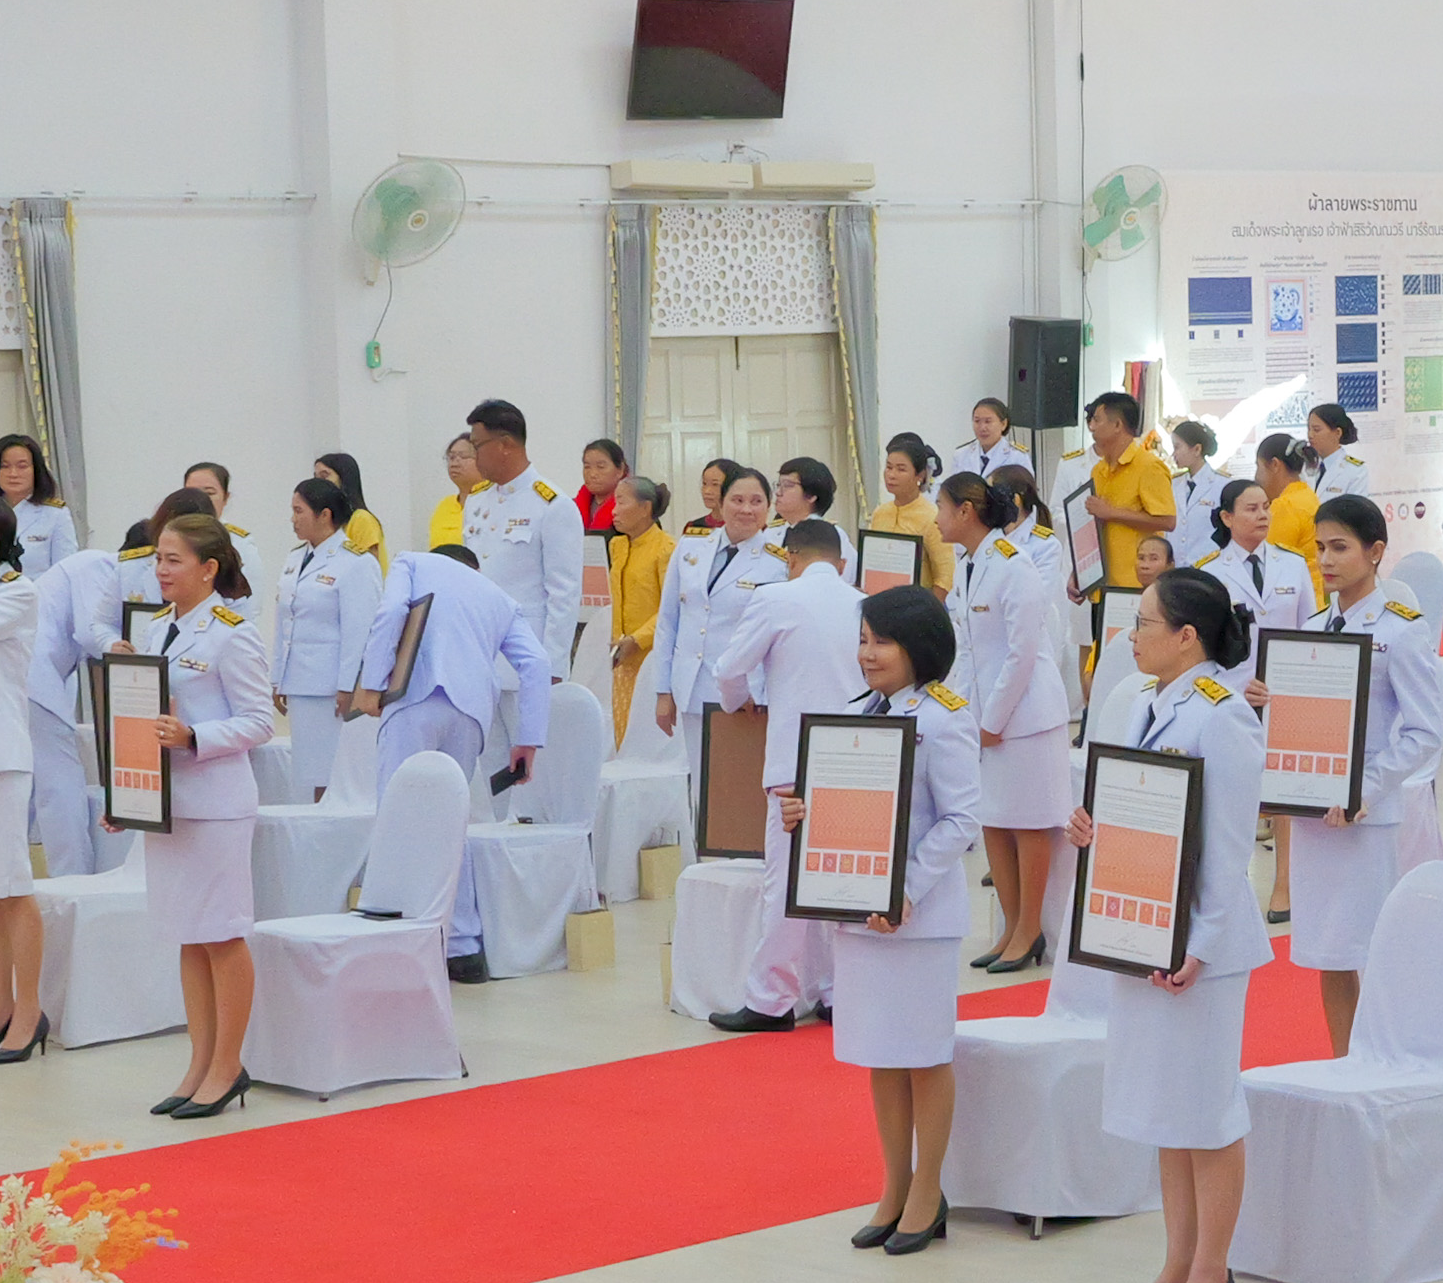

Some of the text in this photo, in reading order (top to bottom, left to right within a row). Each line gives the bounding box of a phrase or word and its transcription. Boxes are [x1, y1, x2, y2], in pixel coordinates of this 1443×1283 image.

[1308, 192, 1418, 211] ผ้าลายพระราชทาน
[1232, 221, 1324, 243] สมเด็จพระเจ้าลูกเธอ
[1327, 221, 1404, 237] เจ้าฟ้าสิริวัณณวรี
